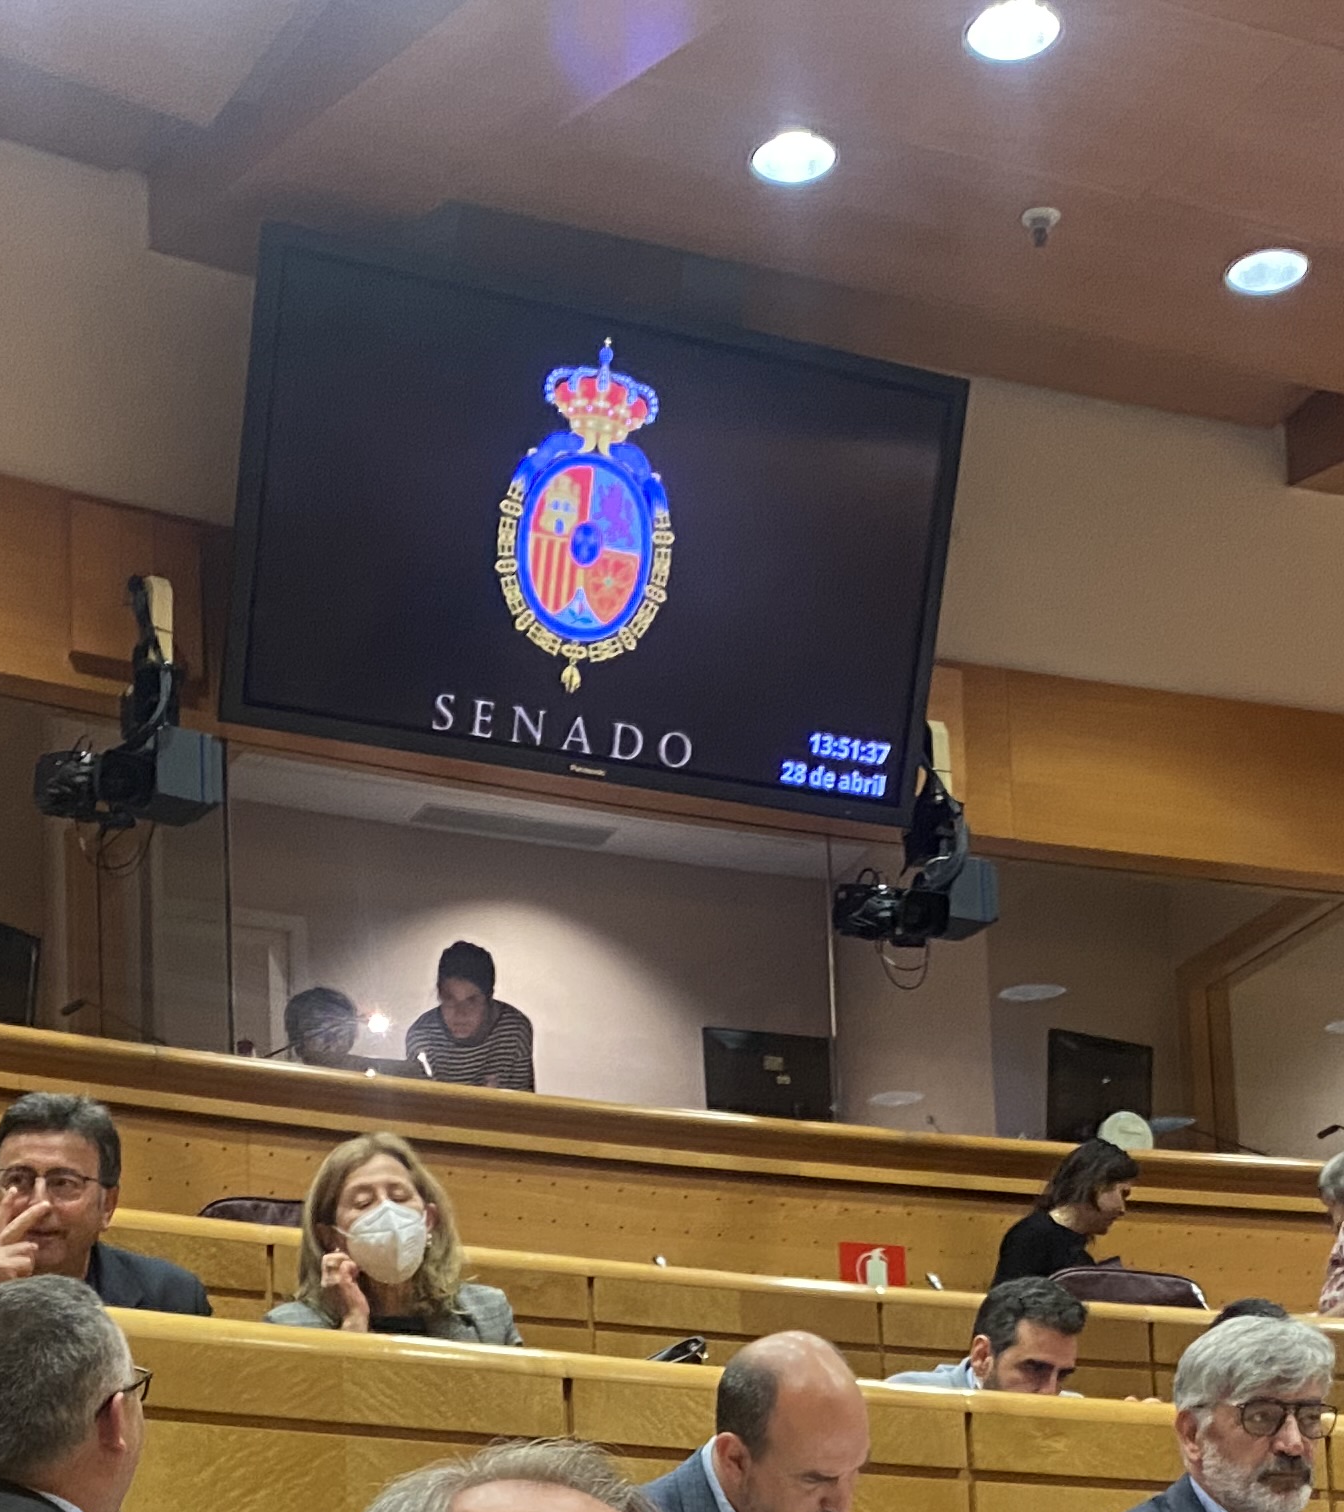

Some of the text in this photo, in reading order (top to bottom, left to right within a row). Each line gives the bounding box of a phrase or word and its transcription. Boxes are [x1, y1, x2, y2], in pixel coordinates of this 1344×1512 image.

[431, 693, 693, 768] SENADO
[809, 732, 891, 765] 13:51:37
[780, 760, 888, 797] 28 de abril
